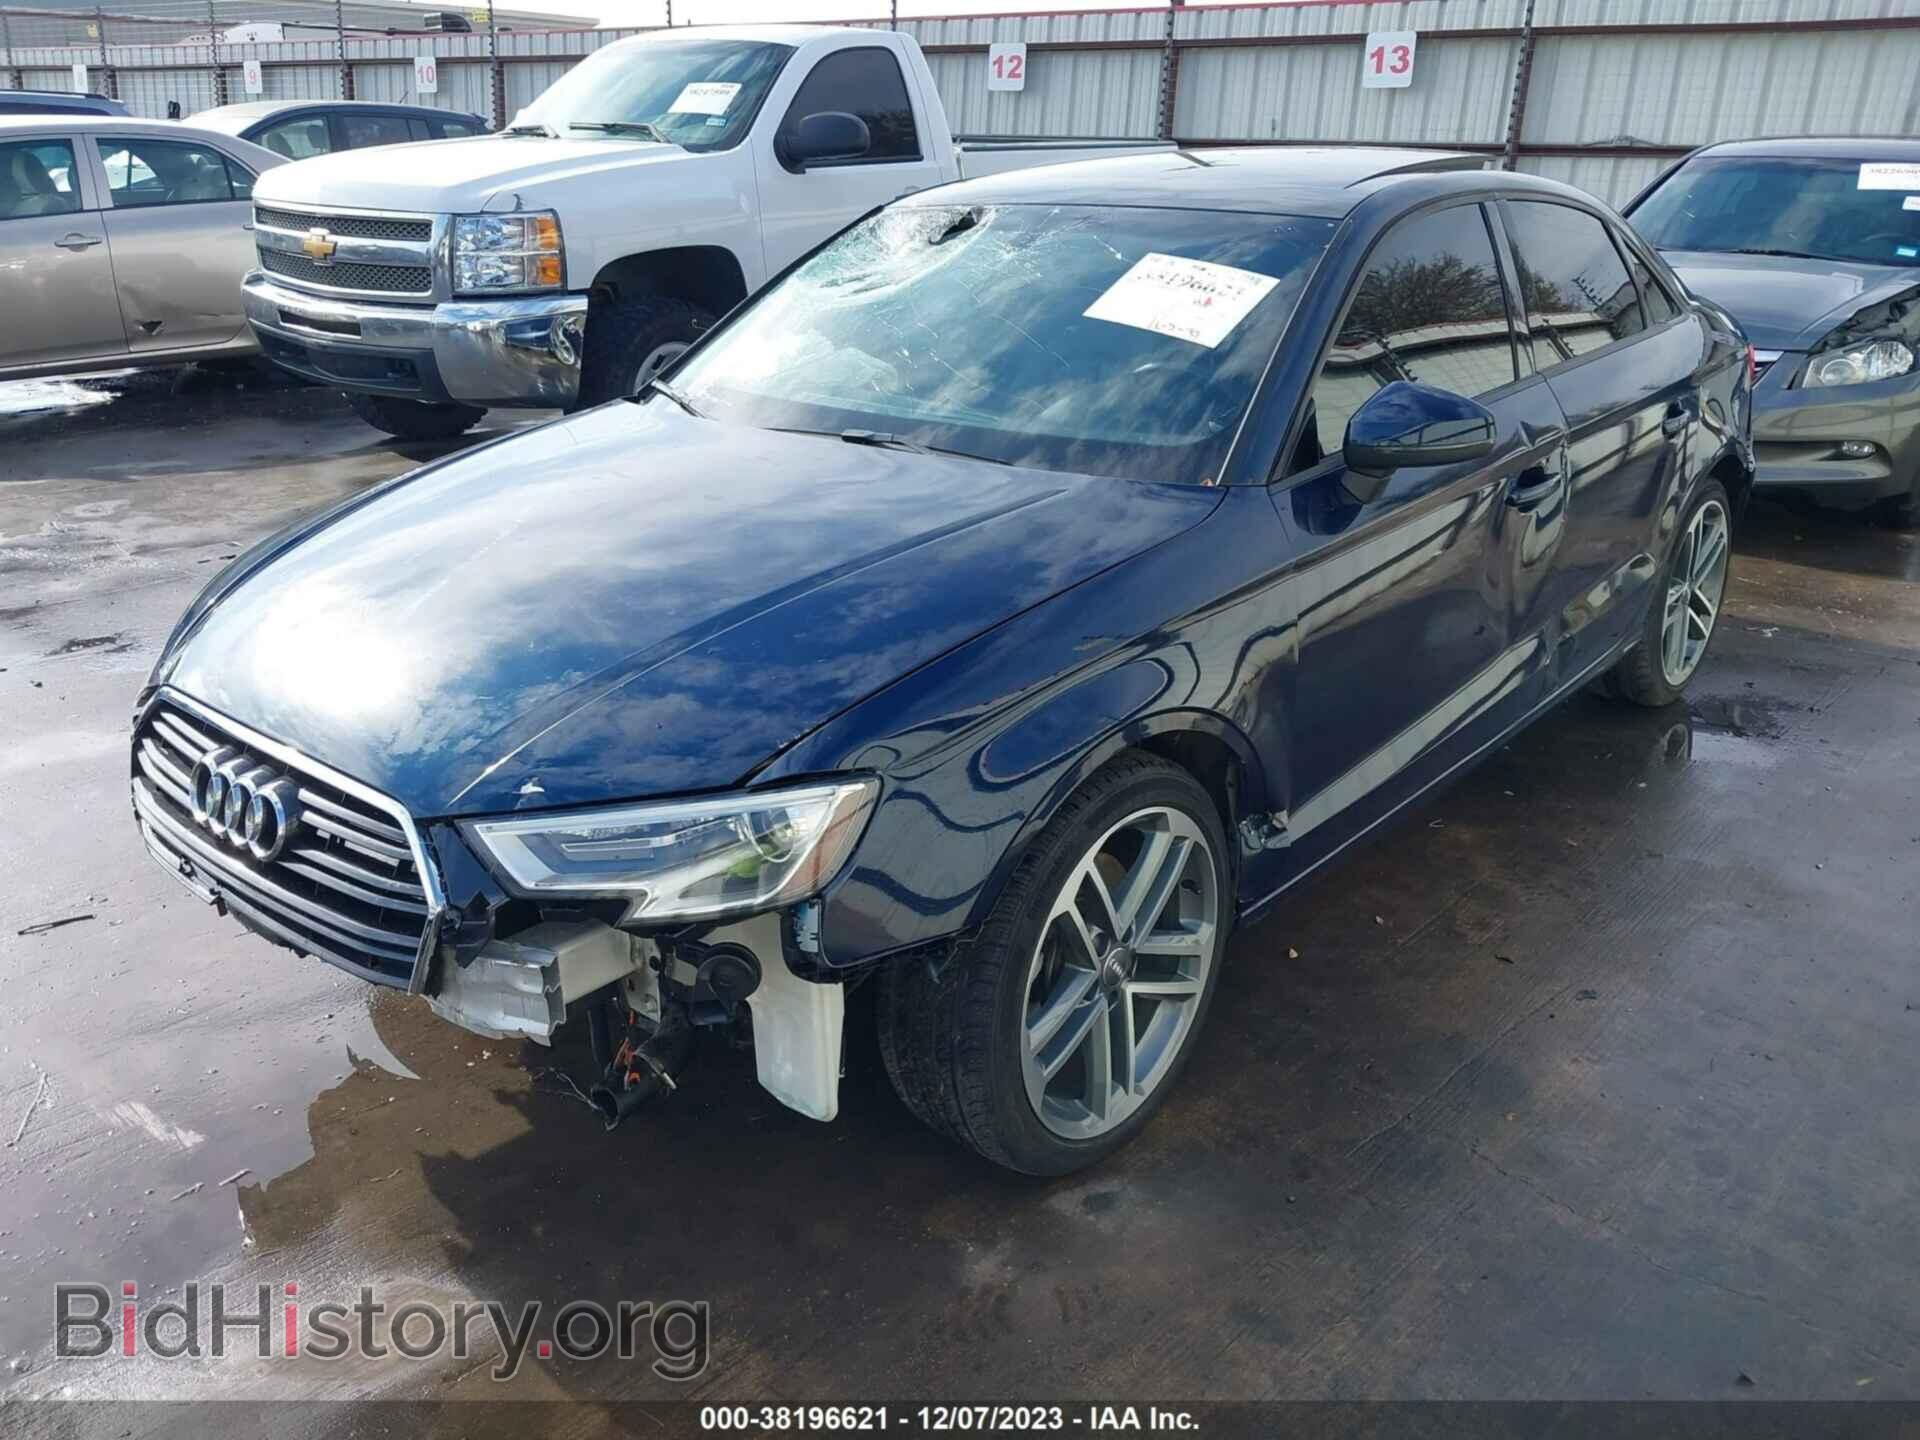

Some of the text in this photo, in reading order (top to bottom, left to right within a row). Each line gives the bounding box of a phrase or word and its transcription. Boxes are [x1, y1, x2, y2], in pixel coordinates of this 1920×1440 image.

[992, 54, 1024, 80] 12
[1369, 44, 1410, 75] 13
[416, 64, 435, 84] 10
